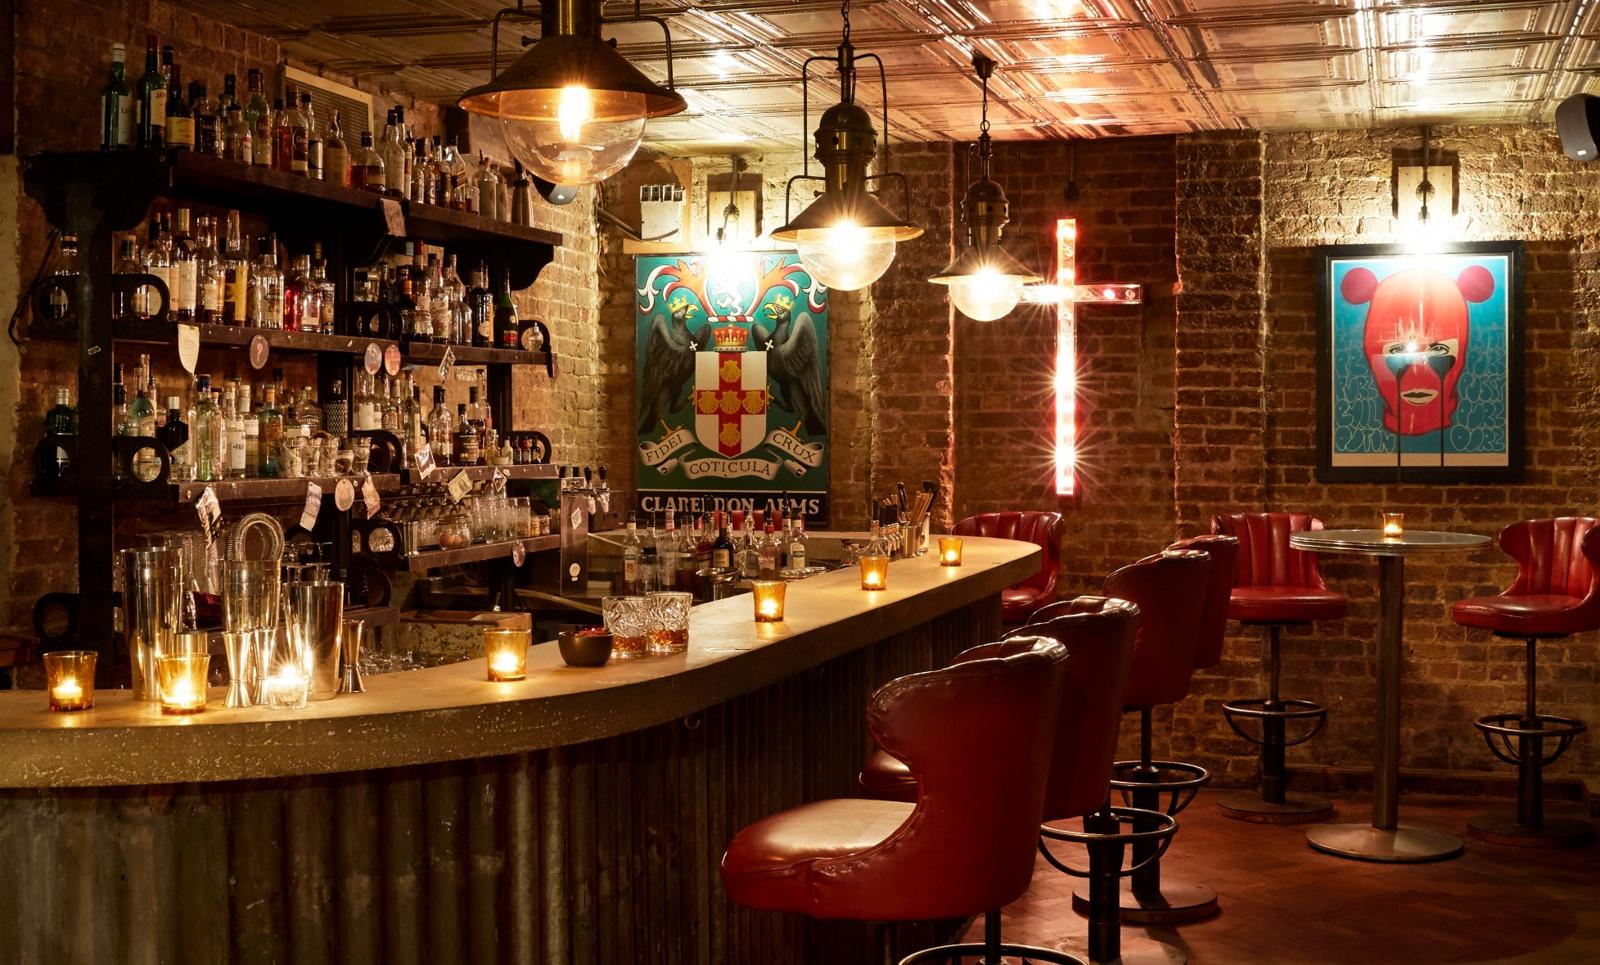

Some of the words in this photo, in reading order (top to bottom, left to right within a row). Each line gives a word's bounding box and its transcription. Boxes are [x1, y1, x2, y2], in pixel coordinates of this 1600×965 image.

[645, 433, 682, 462] FIDEI
[773, 433, 817, 464] CRUX
[690, 461, 771, 476] COTICULA
[641, 496, 754, 513] CLAREDON
